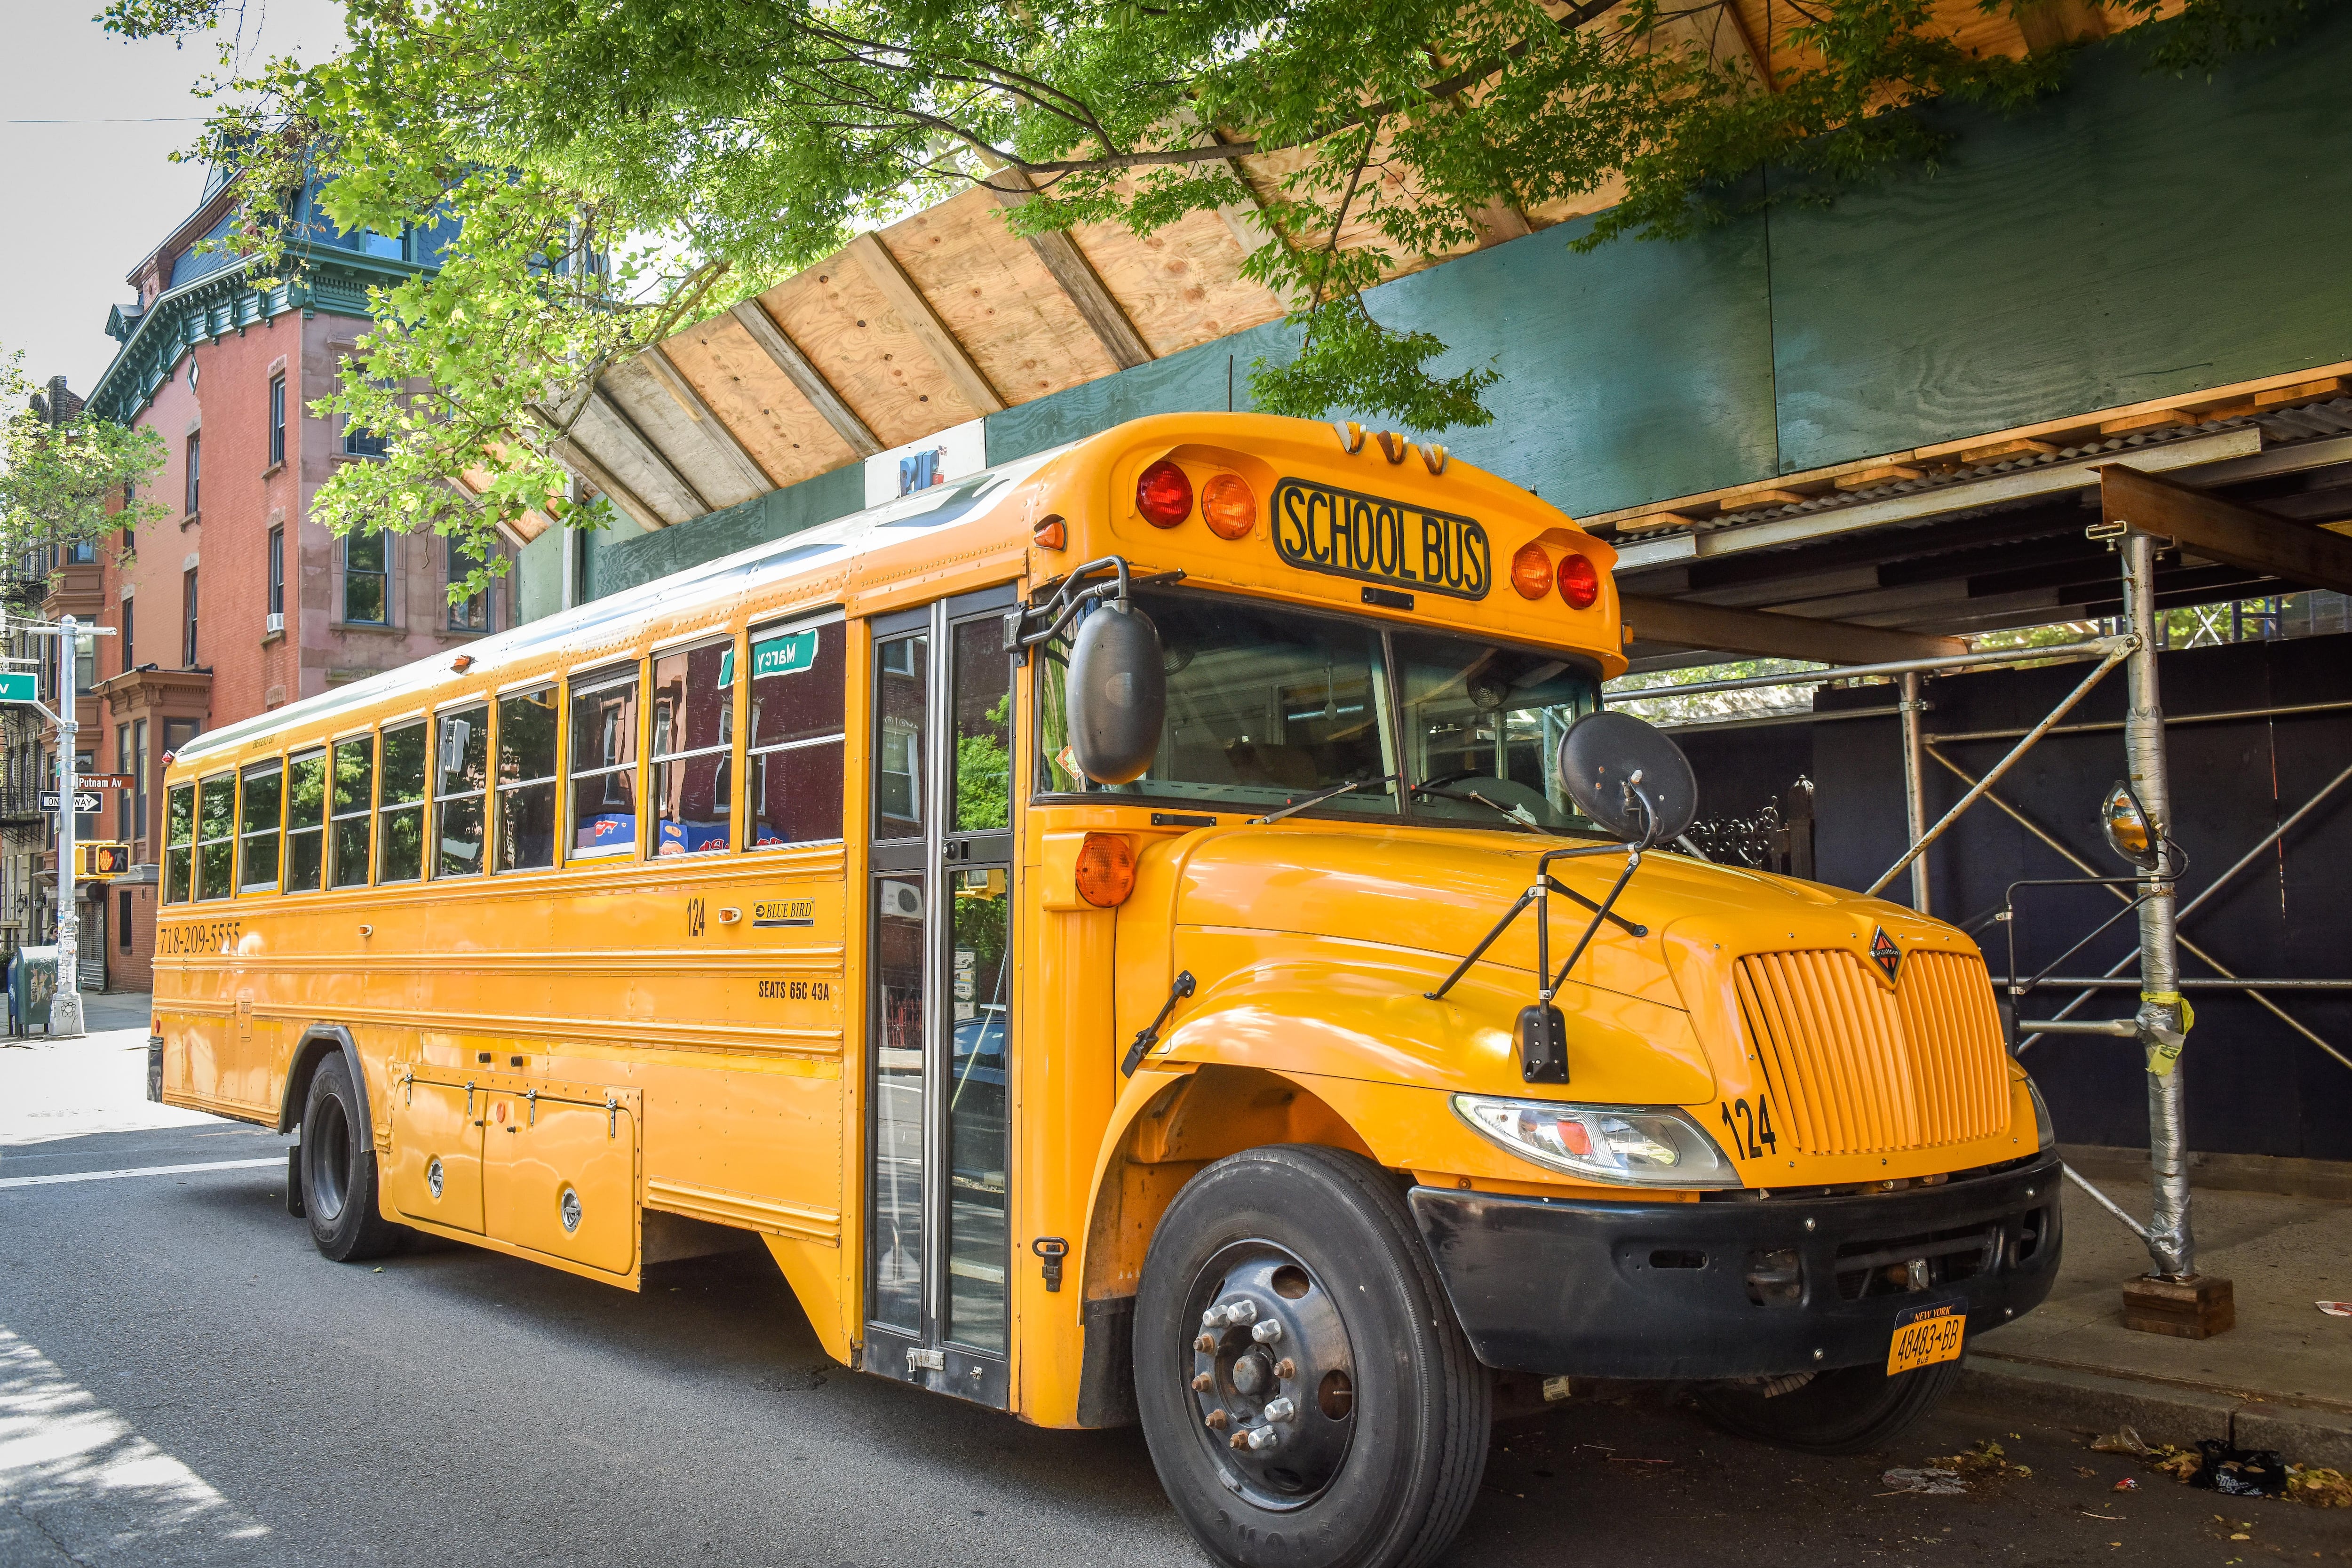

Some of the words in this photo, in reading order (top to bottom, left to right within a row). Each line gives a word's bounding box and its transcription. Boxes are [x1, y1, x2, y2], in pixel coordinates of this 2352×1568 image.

[1284, 486, 1417, 580] SCHOOL
[1422, 515, 1483, 592] BUS
[79, 778, 109, 788] Putnam
[111, 778, 122, 788] Av
[687, 897, 705, 937] 124
[766, 904, 788, 918] BLUE
[790, 902, 811, 917] BIRD
[161, 922, 240, 954] 718-209-5555
[759, 980, 786, 998] SEATS
[790, 981, 807, 1000] 65C
[811, 983, 829, 1001] 43A
[1721, 1094, 1776, 1160] 124
[1914, 1310, 1932, 1322] NEW
[1933, 1305, 1952, 1318] YORK
[1916, 1356, 1929, 1365] BUS
